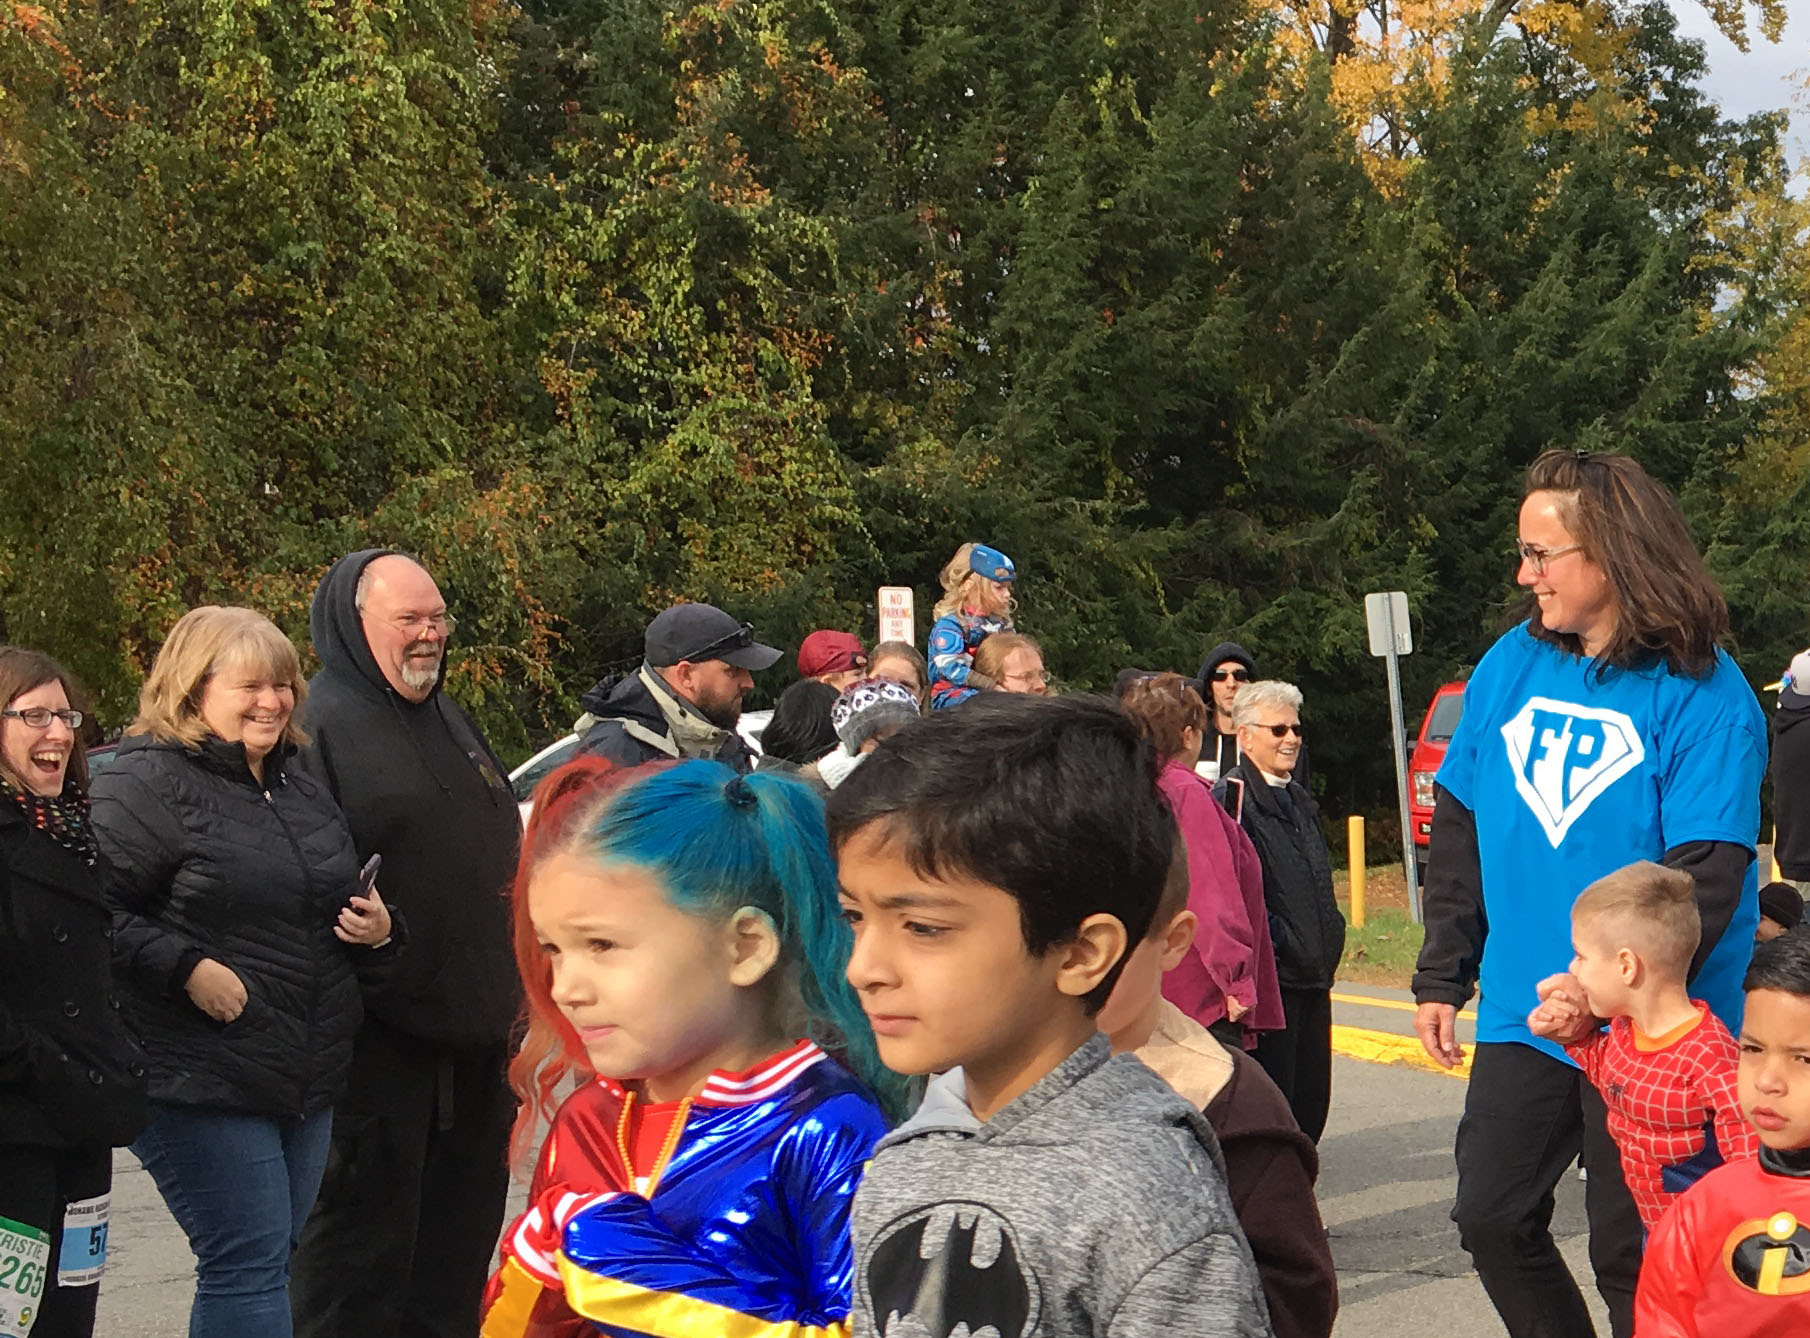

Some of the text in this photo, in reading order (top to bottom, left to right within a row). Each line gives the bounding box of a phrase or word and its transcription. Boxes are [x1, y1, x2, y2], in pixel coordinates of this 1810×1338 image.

[890, 593, 903, 606] NO
[1523, 708, 1607, 813] FP
[0, 1231, 43, 1260] RISTIE
[0, 1252, 45, 1298] 265
